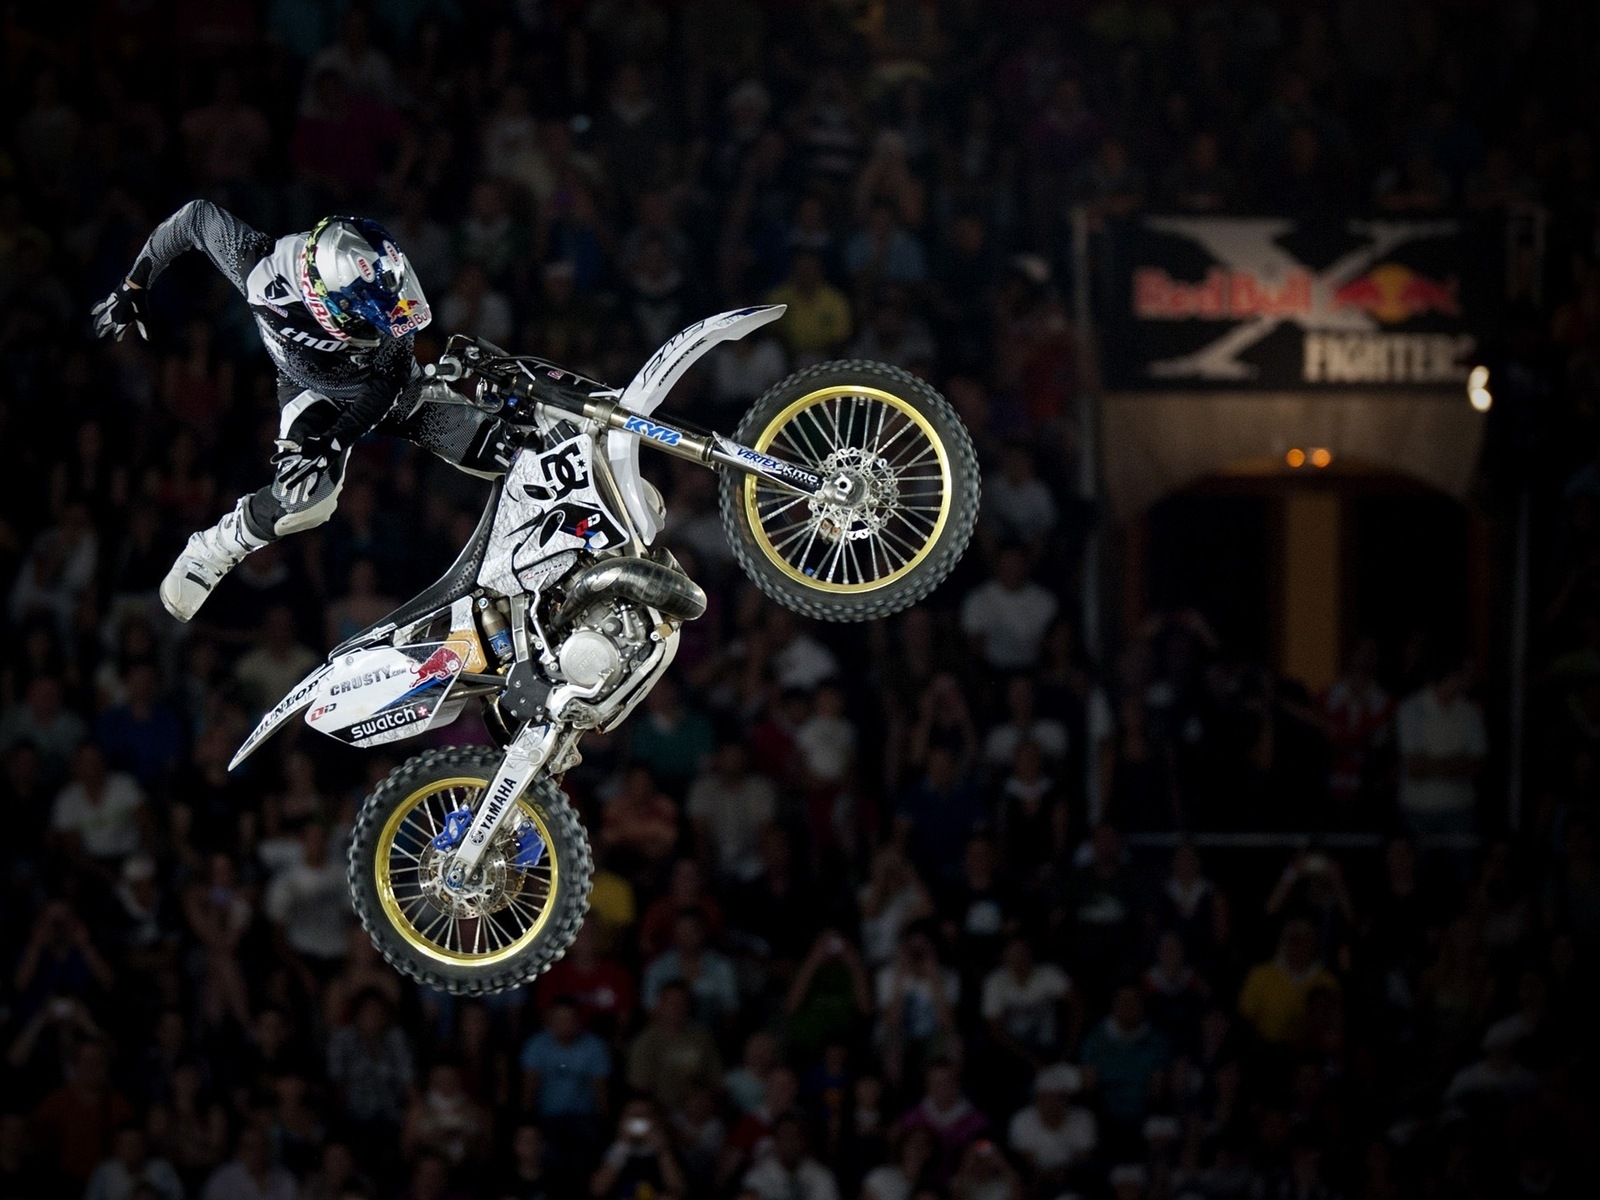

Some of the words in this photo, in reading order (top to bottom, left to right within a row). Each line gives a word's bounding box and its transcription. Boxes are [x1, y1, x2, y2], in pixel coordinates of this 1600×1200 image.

[358, 258, 372, 279] BELL
[391, 316, 416, 338] Red
[413, 307, 430, 325] Bull
[625, 415, 683, 446] KYB
[541, 442, 590, 502] DC
[737, 448, 780, 469] VERTEX
[351, 708, 417, 739] swatch
[481, 777, 517, 830] YAMAHA
